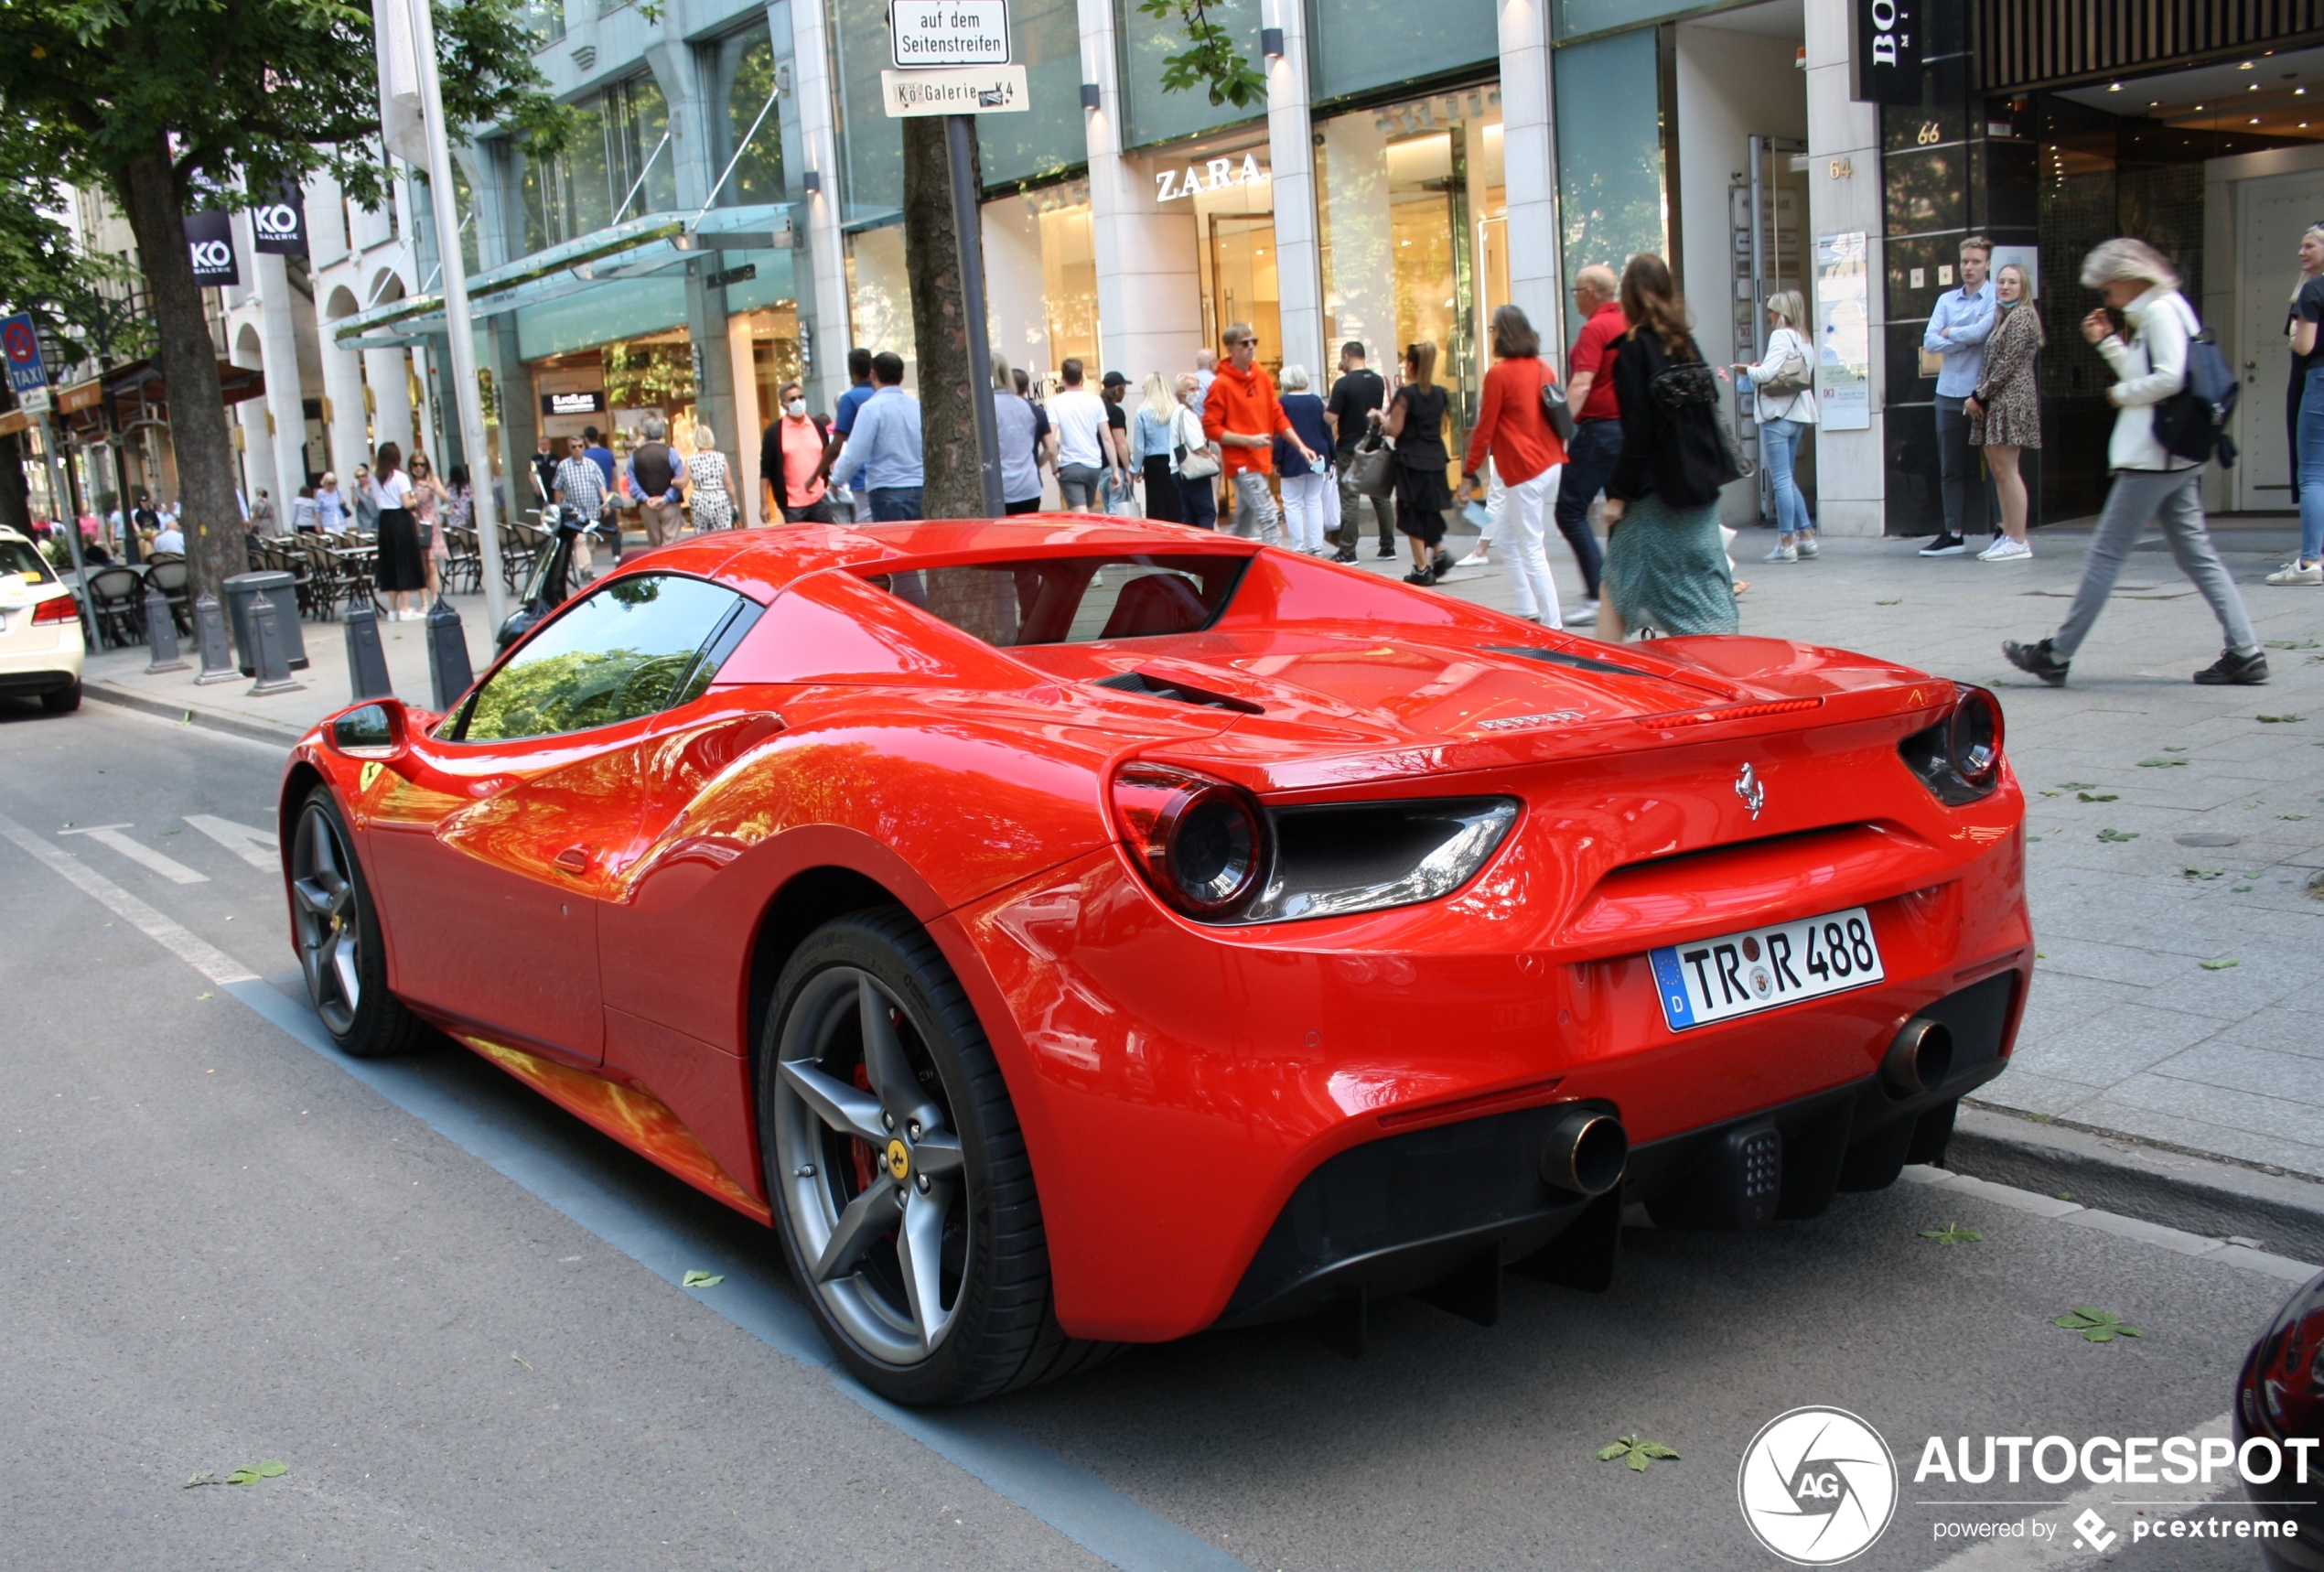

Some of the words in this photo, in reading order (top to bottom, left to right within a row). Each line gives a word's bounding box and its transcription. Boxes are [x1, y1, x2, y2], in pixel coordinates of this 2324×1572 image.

[920, 11, 942, 28] auf
[951, 11, 980, 28] dem
[902, 35, 1001, 53] Seitenstreifen
[1917, 123, 1940, 145] 66
[1156, 153, 1263, 202] ZARA
[1829, 157, 1852, 180] 64
[13, 365, 44, 387] TAXI
[1671, 995, 1684, 1014] D
[1684, 942, 1750, 1009] TR
[1765, 931, 1802, 993] R
[1805, 917, 1874, 982] 488
